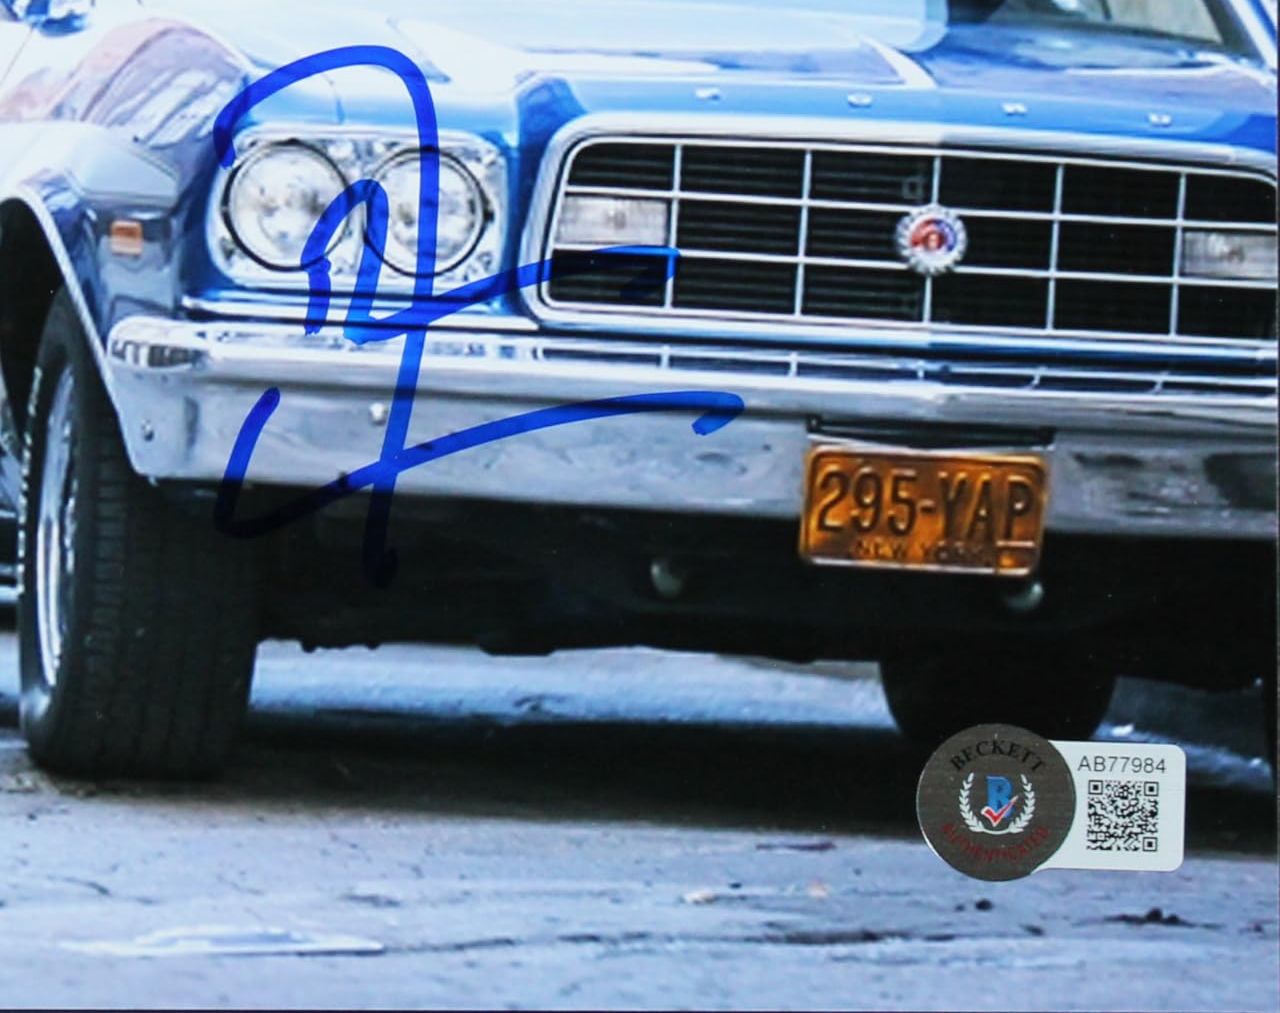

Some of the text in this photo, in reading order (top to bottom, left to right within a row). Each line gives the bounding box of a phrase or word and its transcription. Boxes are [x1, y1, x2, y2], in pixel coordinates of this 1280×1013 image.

[817, 465, 1034, 539] 295-YAP
[949, 739, 1048, 774] BECKETT
[1076, 755, 1167, 775] AB77984
